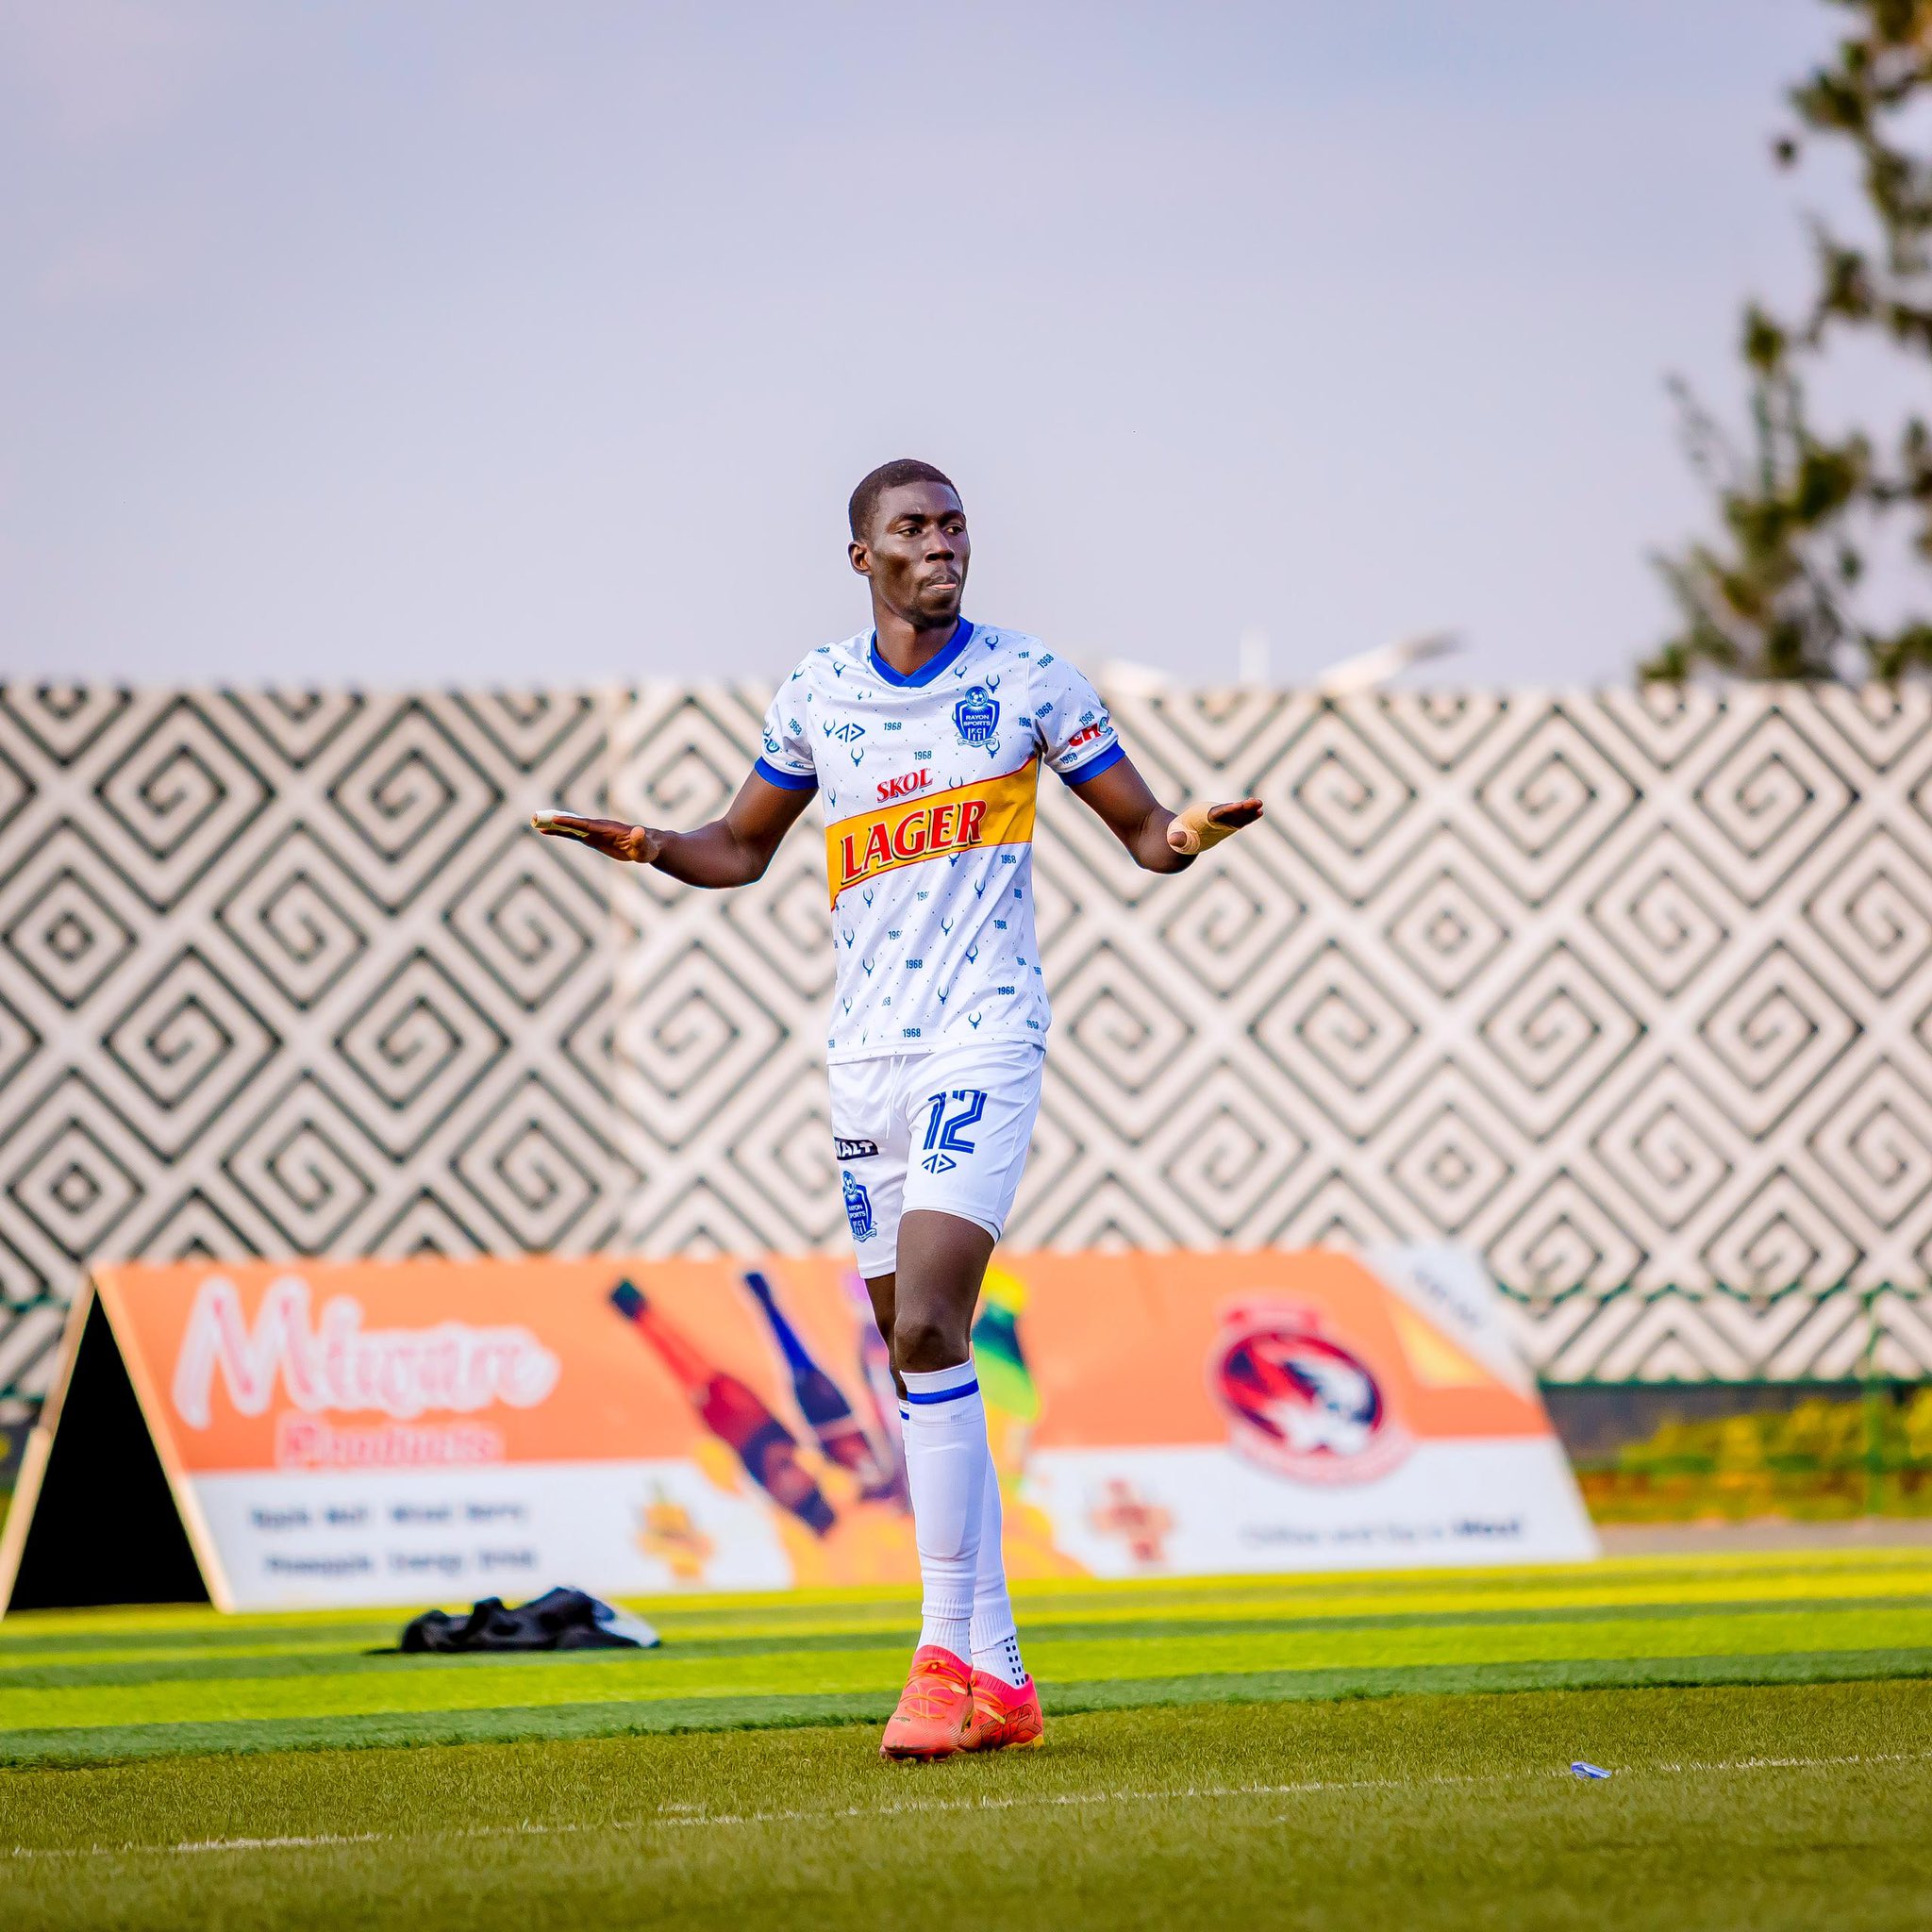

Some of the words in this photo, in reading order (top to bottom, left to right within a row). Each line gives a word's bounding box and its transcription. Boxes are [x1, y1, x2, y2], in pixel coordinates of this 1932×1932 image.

[1038, 653, 1055, 669] 1968
[1035, 702, 1054, 719] 1968
[1079, 710, 1095, 726] 1968
[789, 717, 803, 736] 1968
[883, 722, 902, 731] 1968
[913, 750, 932, 760] 1968
[1058, 752, 1078, 765] 1968
[876, 768, 934, 803] SKOL
[841, 800, 988, 885] LAGER
[1000, 854, 1017, 864] 1968
[905, 958, 924, 970] 1968
[997, 985, 1015, 995] 1968
[902, 1027, 922, 1038] 1968
[923, 1089, 989, 1156] 12
